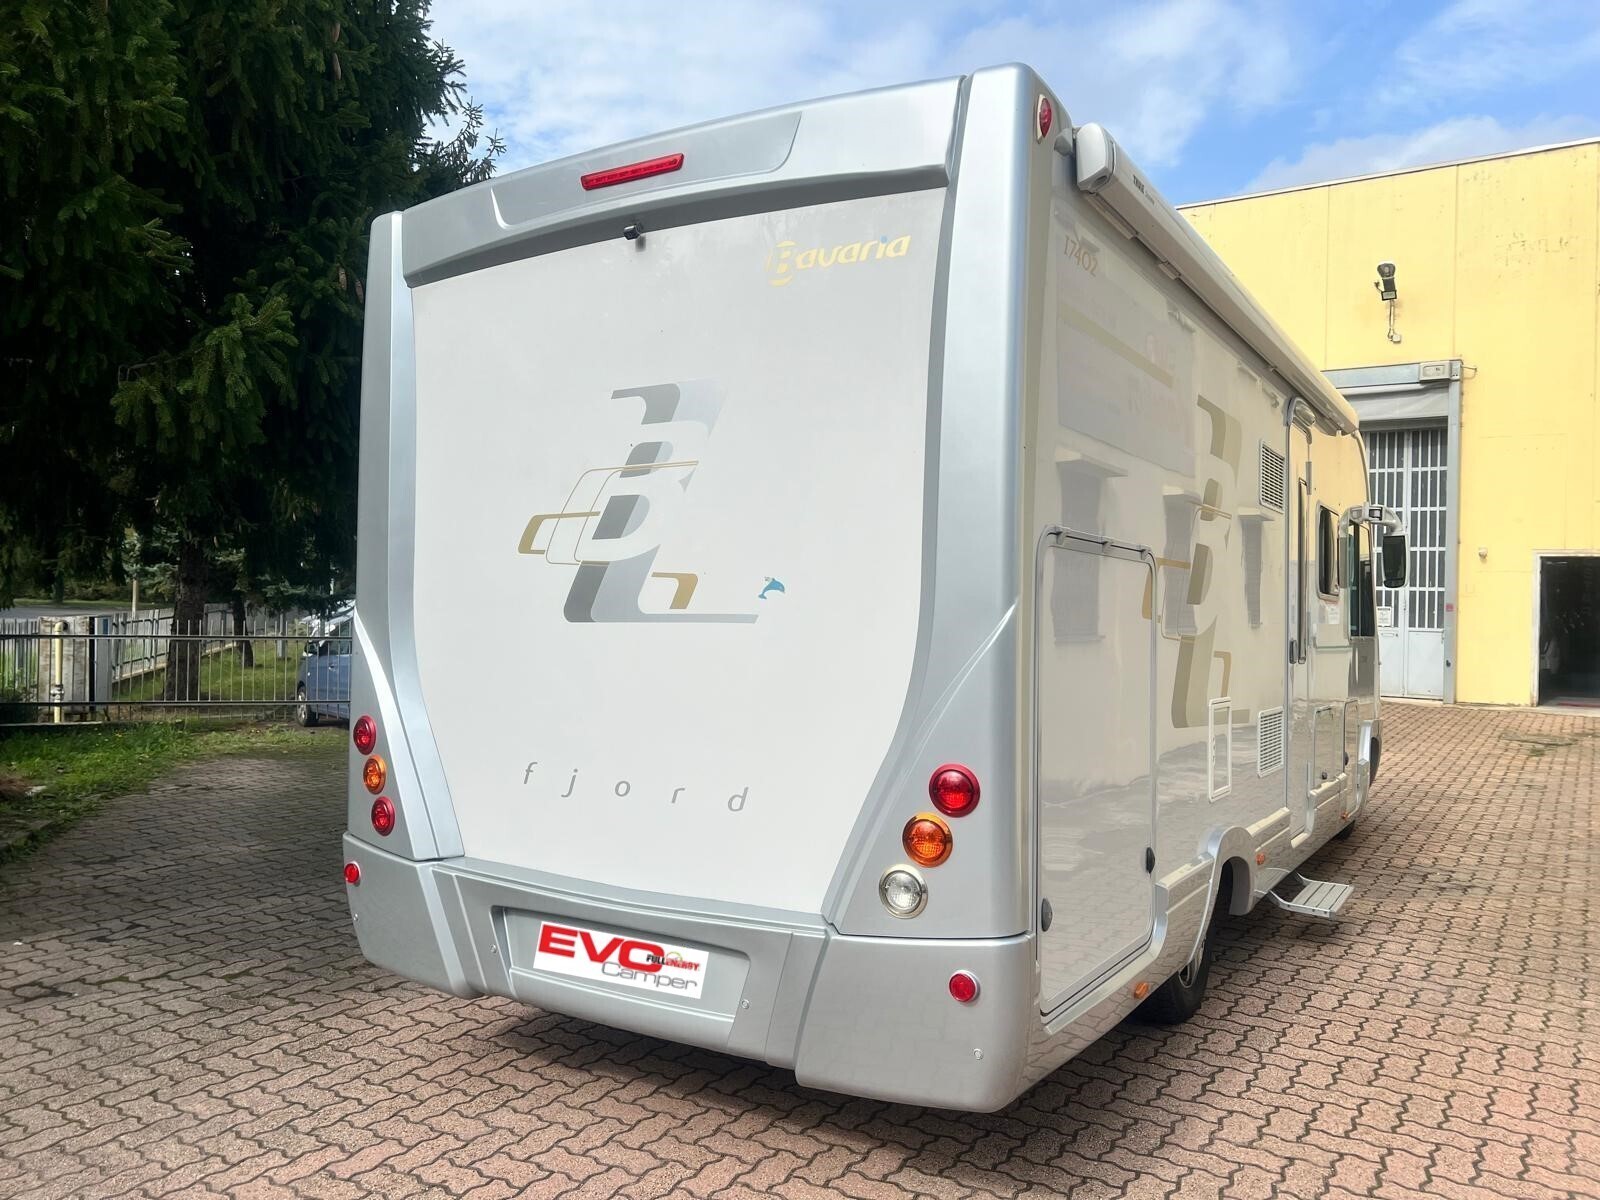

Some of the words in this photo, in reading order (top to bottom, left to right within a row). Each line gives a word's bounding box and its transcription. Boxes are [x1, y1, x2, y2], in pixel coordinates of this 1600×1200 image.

[523, 761, 750, 812] fjord
[538, 923, 665, 973] EVO
[601, 961, 698, 990] Camper
